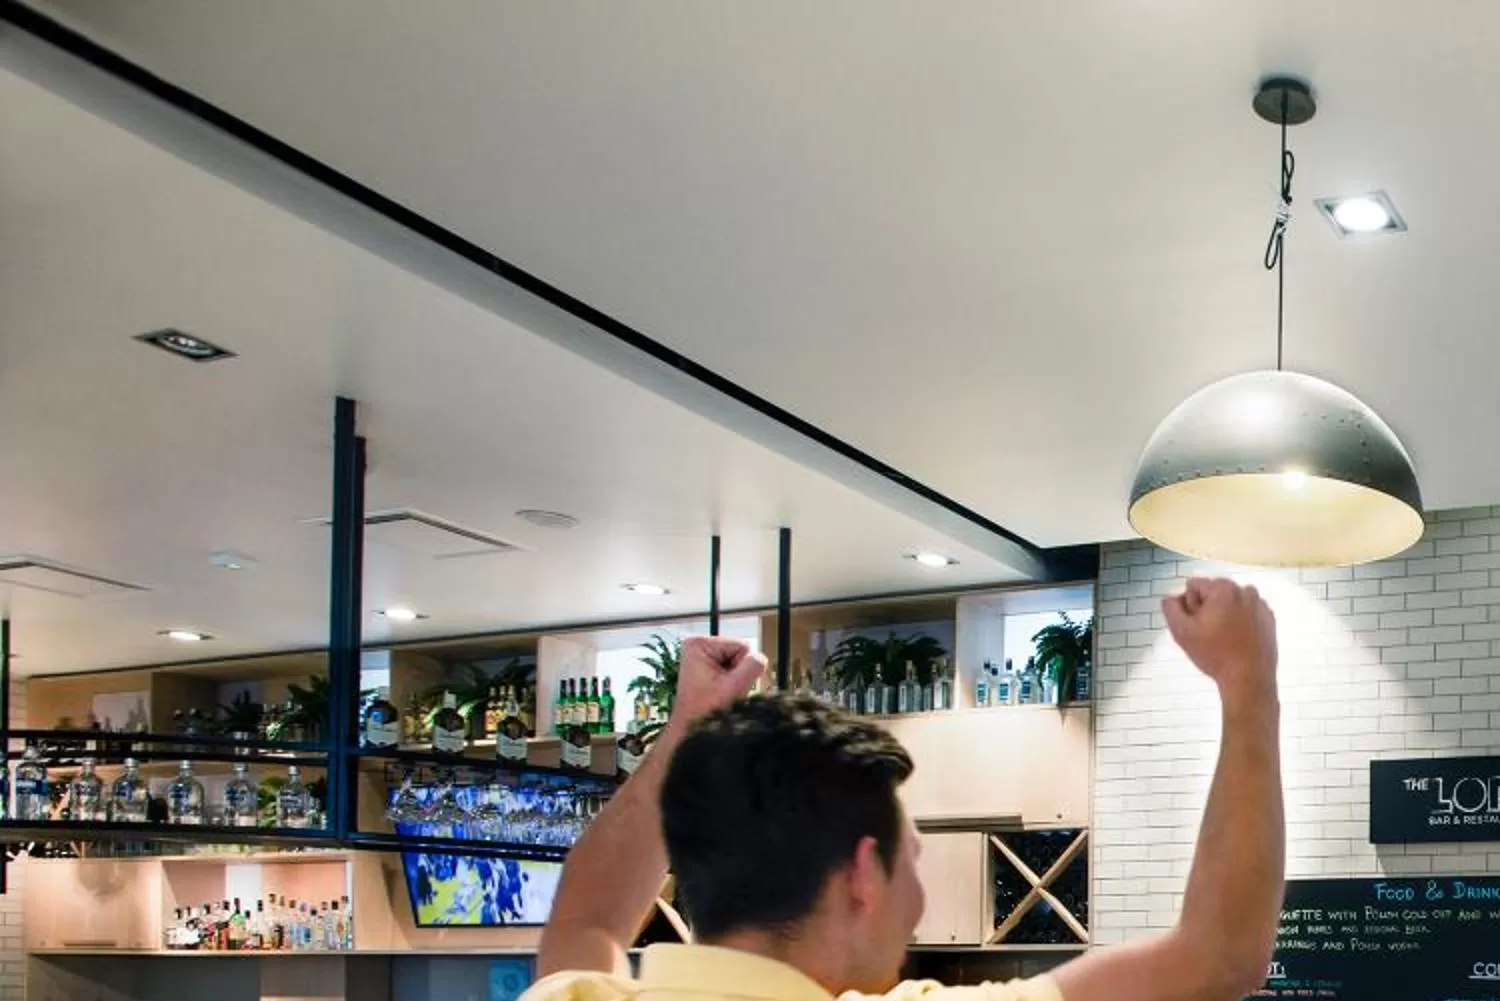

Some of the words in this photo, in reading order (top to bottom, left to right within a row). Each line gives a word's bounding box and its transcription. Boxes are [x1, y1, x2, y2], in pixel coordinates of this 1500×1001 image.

[1402, 777, 1429, 791] THE
[1428, 815, 1451, 826] BAR
[1453, 815, 1461, 825] &
[1425, 879, 1444, 901] &
